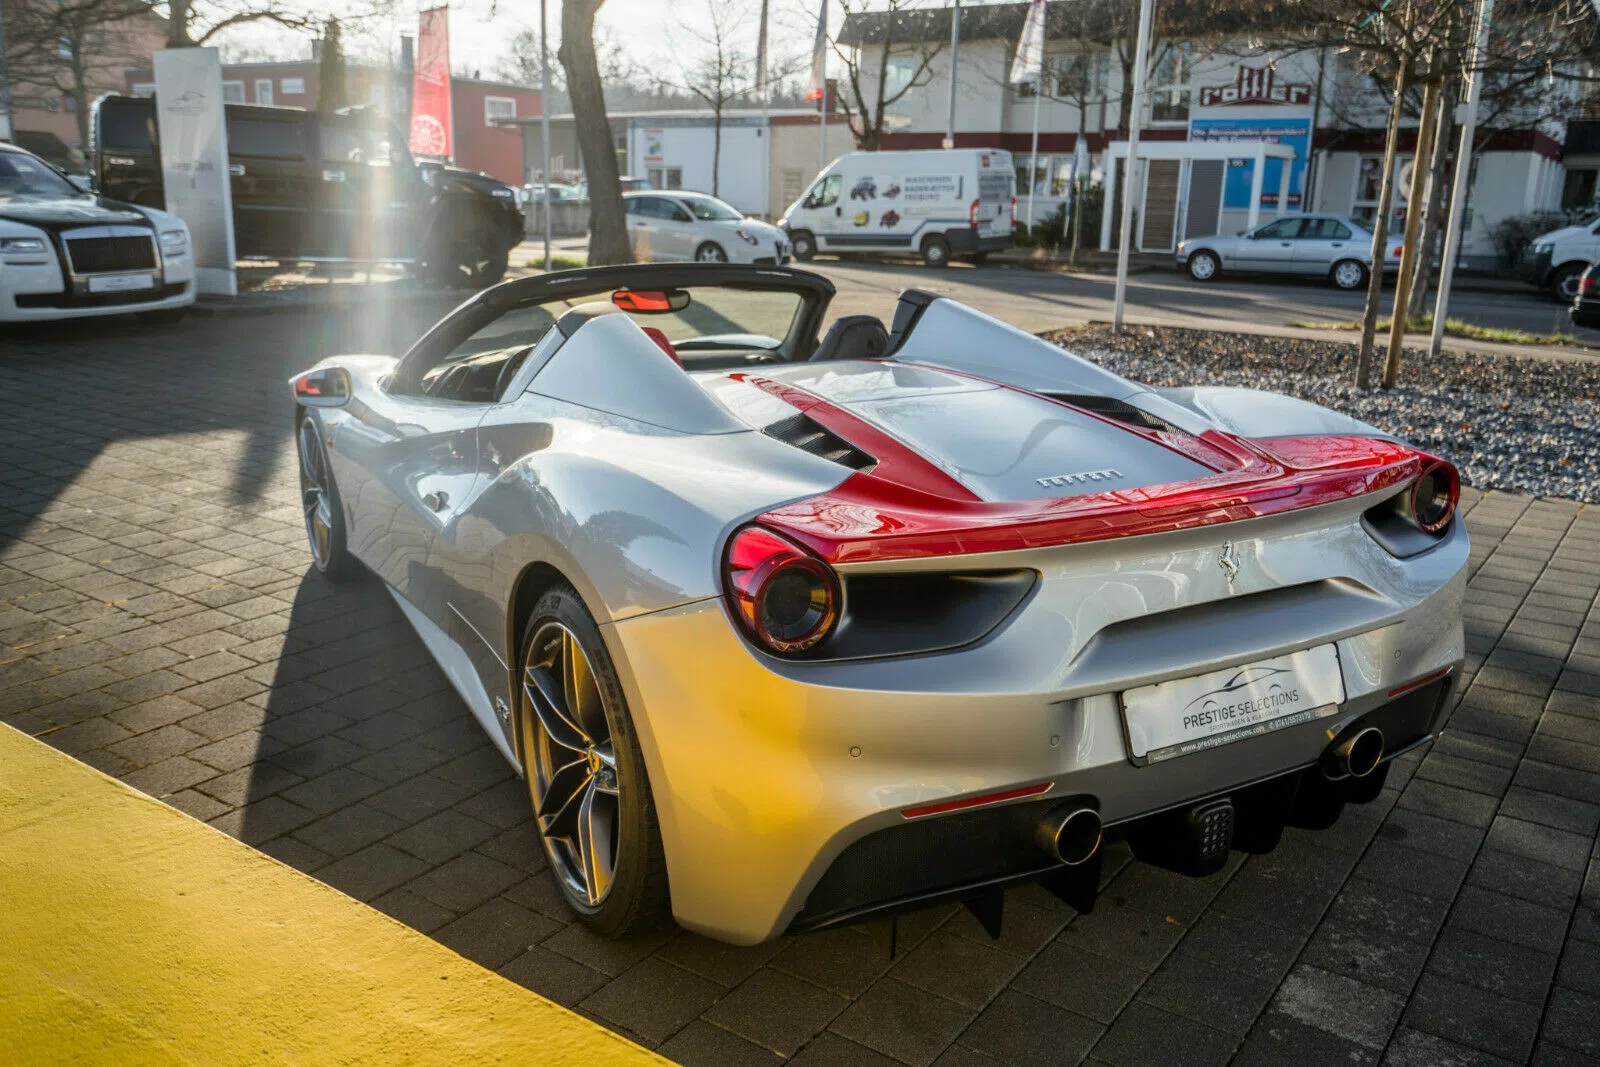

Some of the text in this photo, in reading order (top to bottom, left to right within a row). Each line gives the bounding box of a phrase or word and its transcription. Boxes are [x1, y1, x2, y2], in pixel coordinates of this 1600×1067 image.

[1201, 65, 1310, 105] rottler
[1036, 468, 1124, 489] Ferrari
[1183, 705, 1236, 730] PRESTIGE
[1238, 689, 1299, 716] SELECTIONS
[1180, 725, 1265, 753] www.prestige-selections.com
